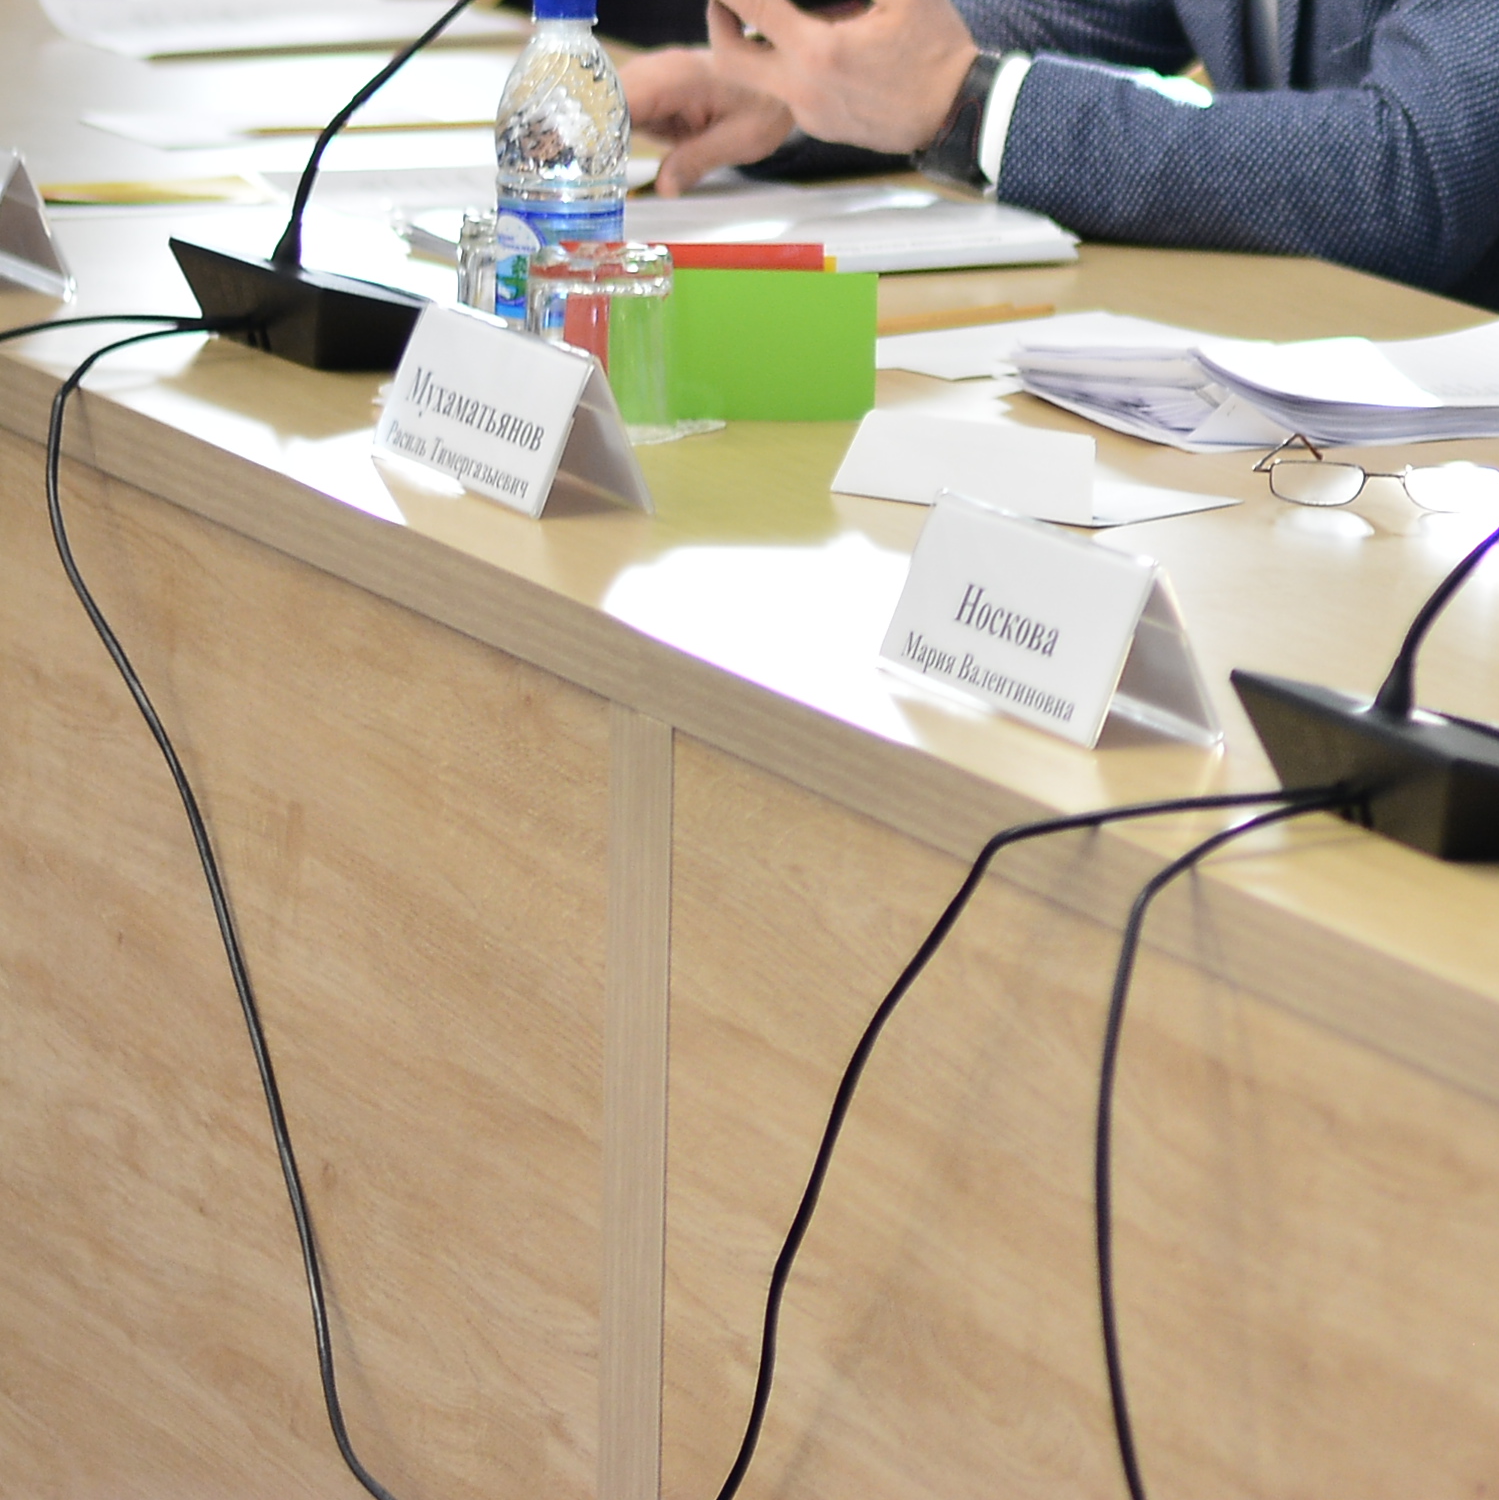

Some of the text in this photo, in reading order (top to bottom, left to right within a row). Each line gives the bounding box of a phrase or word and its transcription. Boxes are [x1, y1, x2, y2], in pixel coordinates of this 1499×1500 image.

[406, 367, 545, 453] Мухаматьянов
[386, 419, 529, 500] Расиль Тимергазыевич
[954, 584, 1060, 658] Носкова
[902, 631, 1075, 722] Мария Валентиновна
